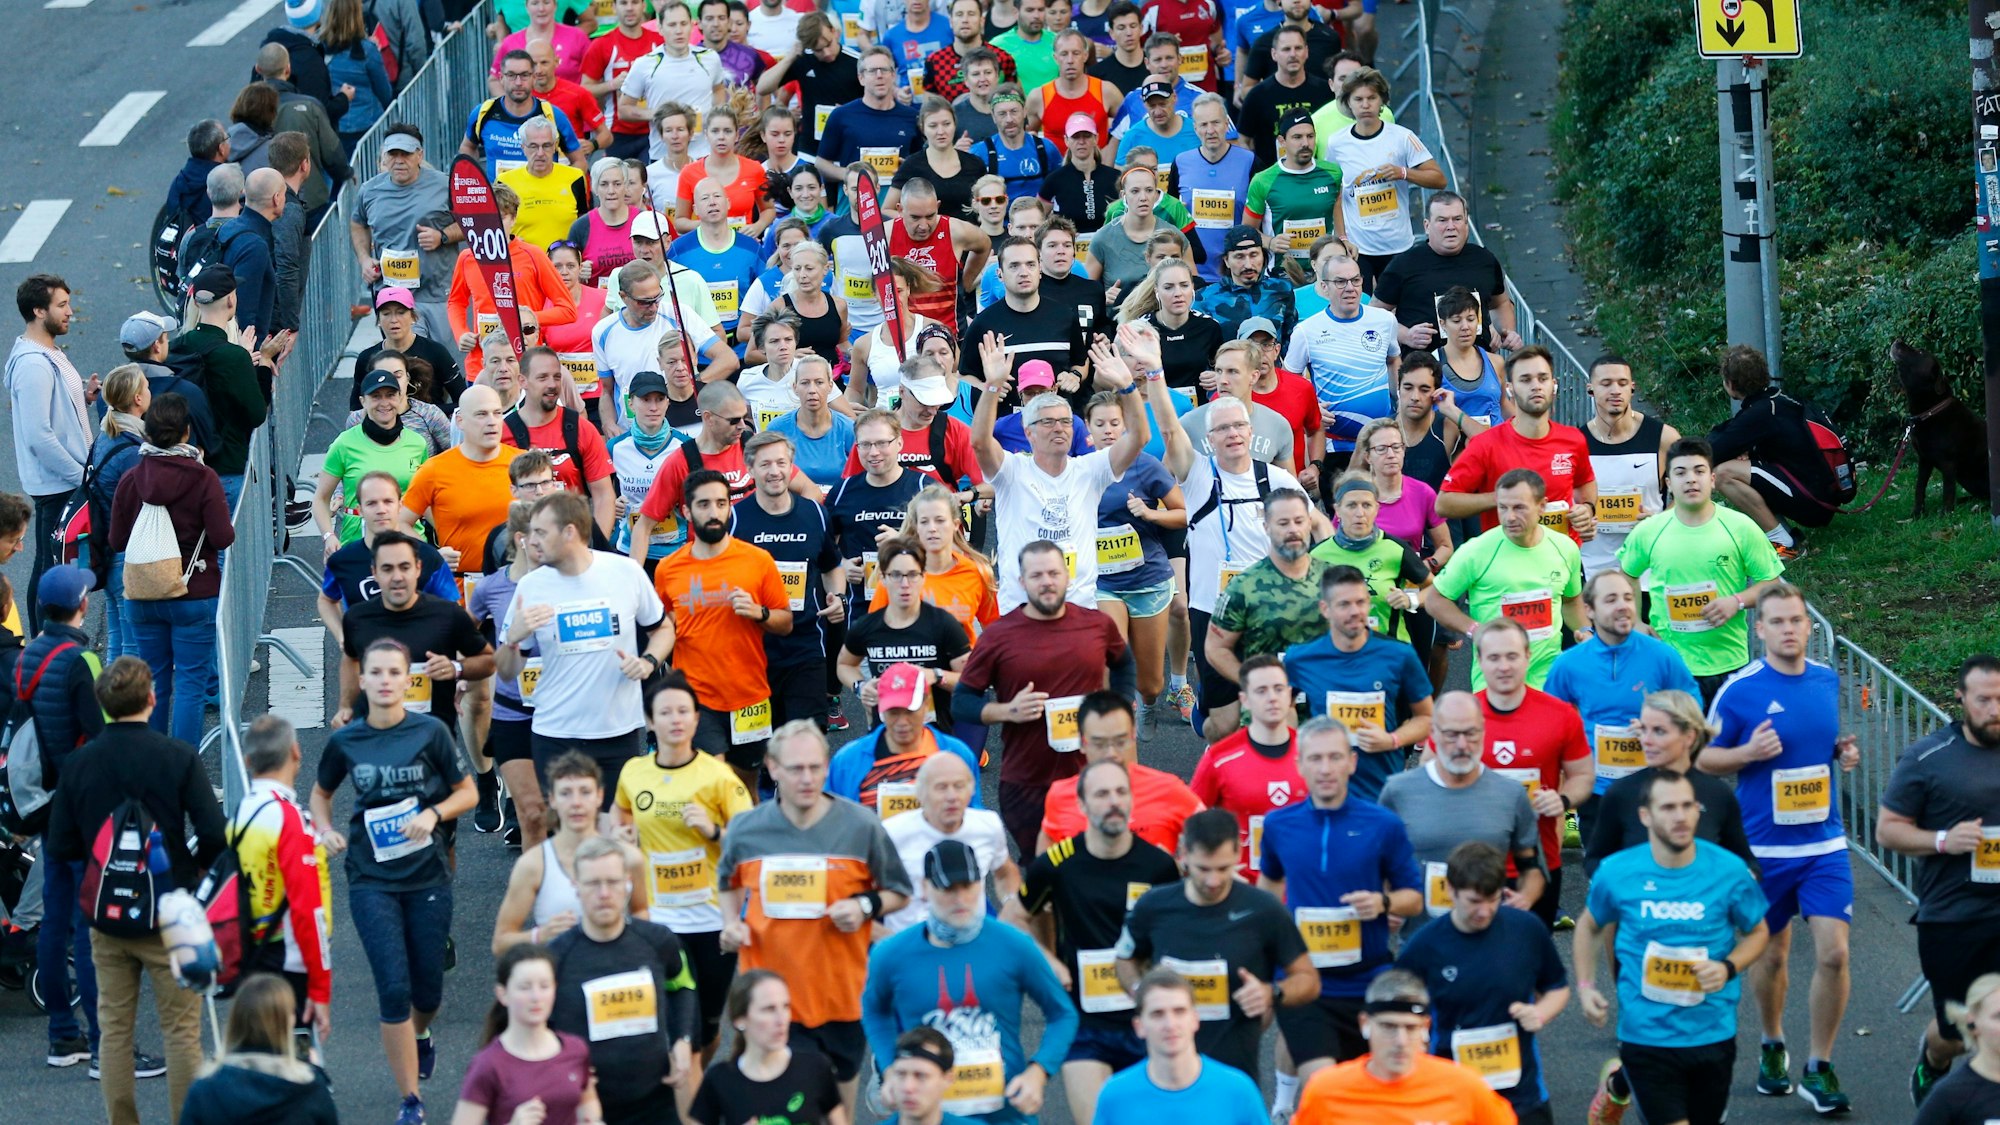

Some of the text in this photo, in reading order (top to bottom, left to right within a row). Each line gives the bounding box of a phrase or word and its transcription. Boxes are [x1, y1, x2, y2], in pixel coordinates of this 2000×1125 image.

[869, 157, 894, 167] 11275
[1200, 200, 1228, 210] 19015
[1360, 192, 1393, 206] F19017
[462, 217, 474, 227] SUB
[467, 228, 506, 261] 2:00
[387, 259, 412, 270] 14887
[623, 485, 652, 494] MARATH
[1600, 497, 1635, 509] 18415
[1096, 535, 1134, 550] F21177
[1107, 552, 1128, 560] Isabel
[1673, 594, 1710, 609] 24769
[1509, 602, 1545, 617] 24770
[564, 611, 603, 627] 18045
[574, 628, 596, 638] Klaus
[867, 645, 937, 659] WE RUN THIS
[1338, 707, 1377, 719] 17762
[1604, 740, 1642, 752] 17693
[379, 764, 424, 788] XLETIX
[1784, 782, 1823, 796] 21608
[657, 863, 701, 879] F26137
[1640, 900, 1705, 920] nosse
[1308, 925, 1350, 937] 19179
[601, 990, 643, 1006] 24219
[1467, 1043, 1509, 1060] 15641
